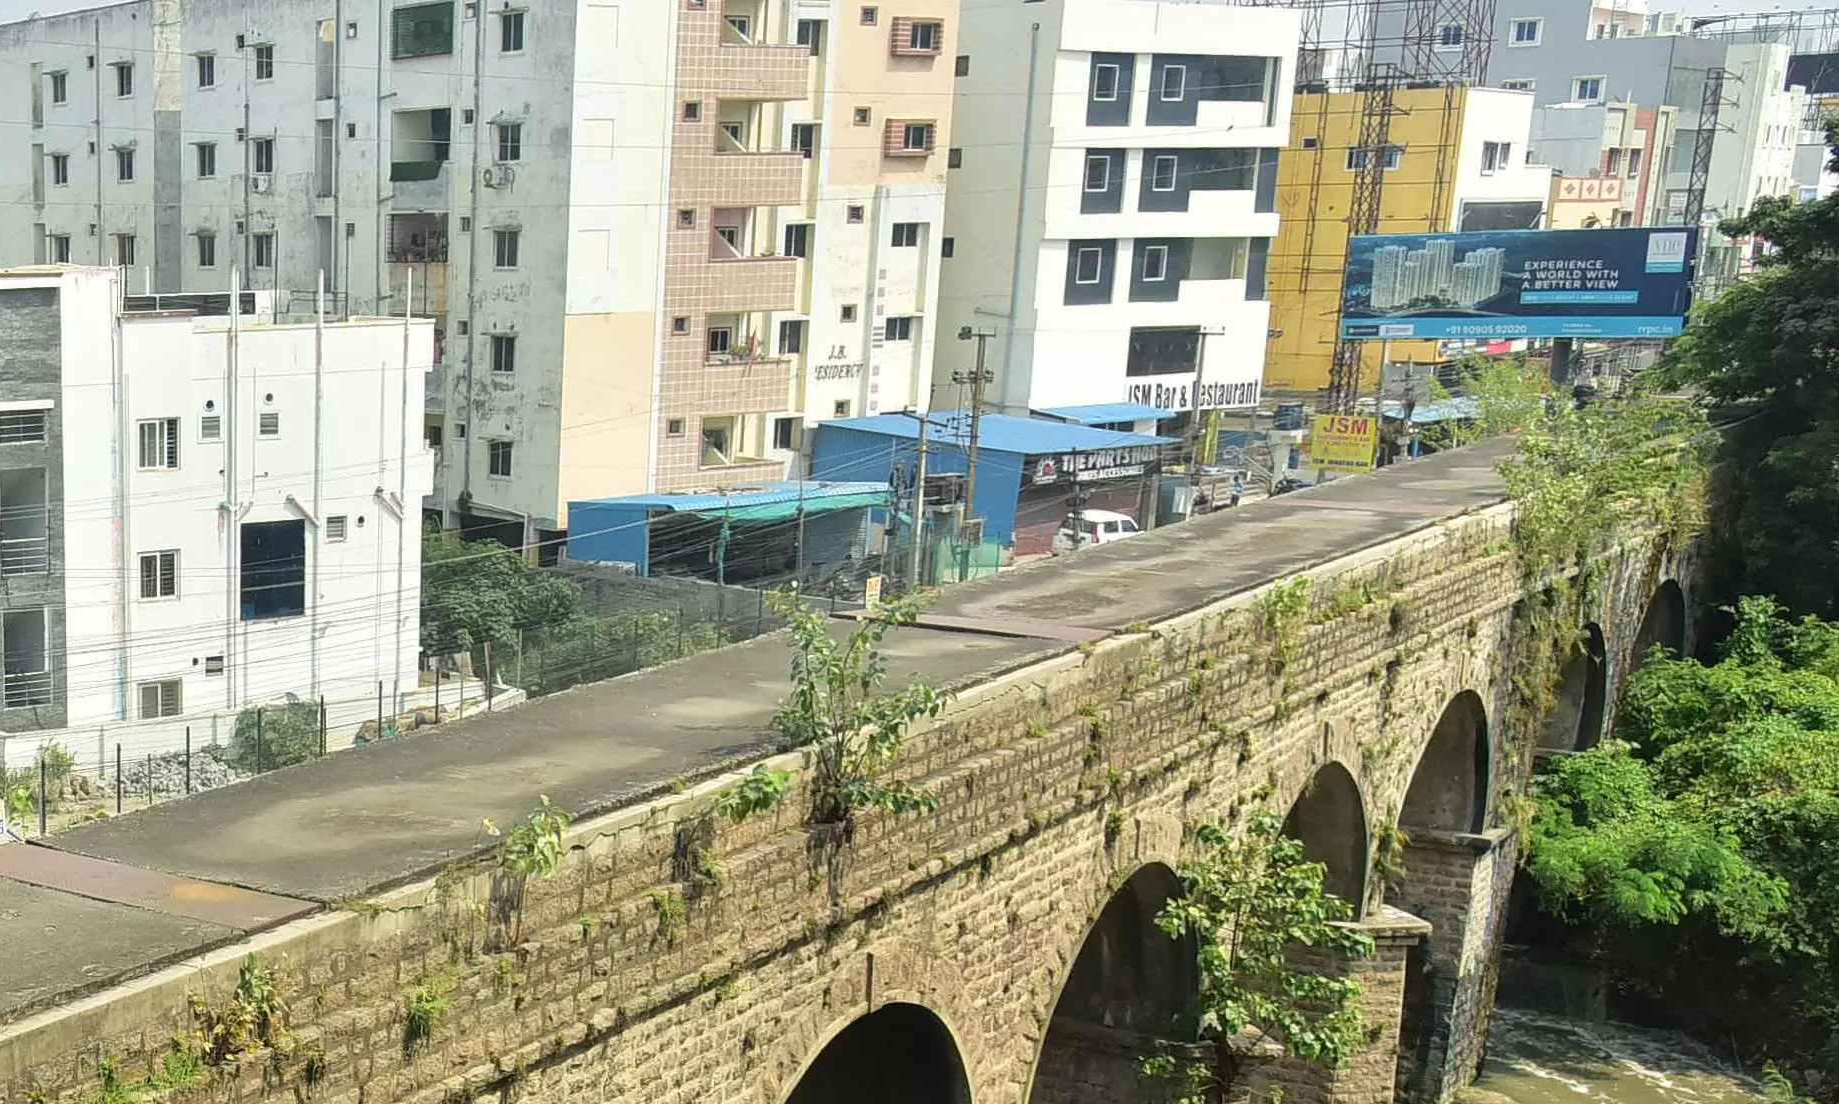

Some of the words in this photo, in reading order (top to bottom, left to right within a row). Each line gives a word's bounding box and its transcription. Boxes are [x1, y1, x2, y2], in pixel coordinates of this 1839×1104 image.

[1524, 260, 1604, 270] EXPERIENCE
[1522, 271, 1531, 280] A
[1536, 270, 1582, 280] WORLD
[1585, 269, 1619, 279] WITH
[1521, 280, 1531, 290] A
[1535, 280, 1582, 290] BETTER
[1585, 280, 1619, 290] VIEW
[814, 363, 864, 380] ESIDENCY
[1155, 383, 1177, 409] Bar
[1179, 385, 1188, 408] &
[1323, 417, 1369, 435] JSM
